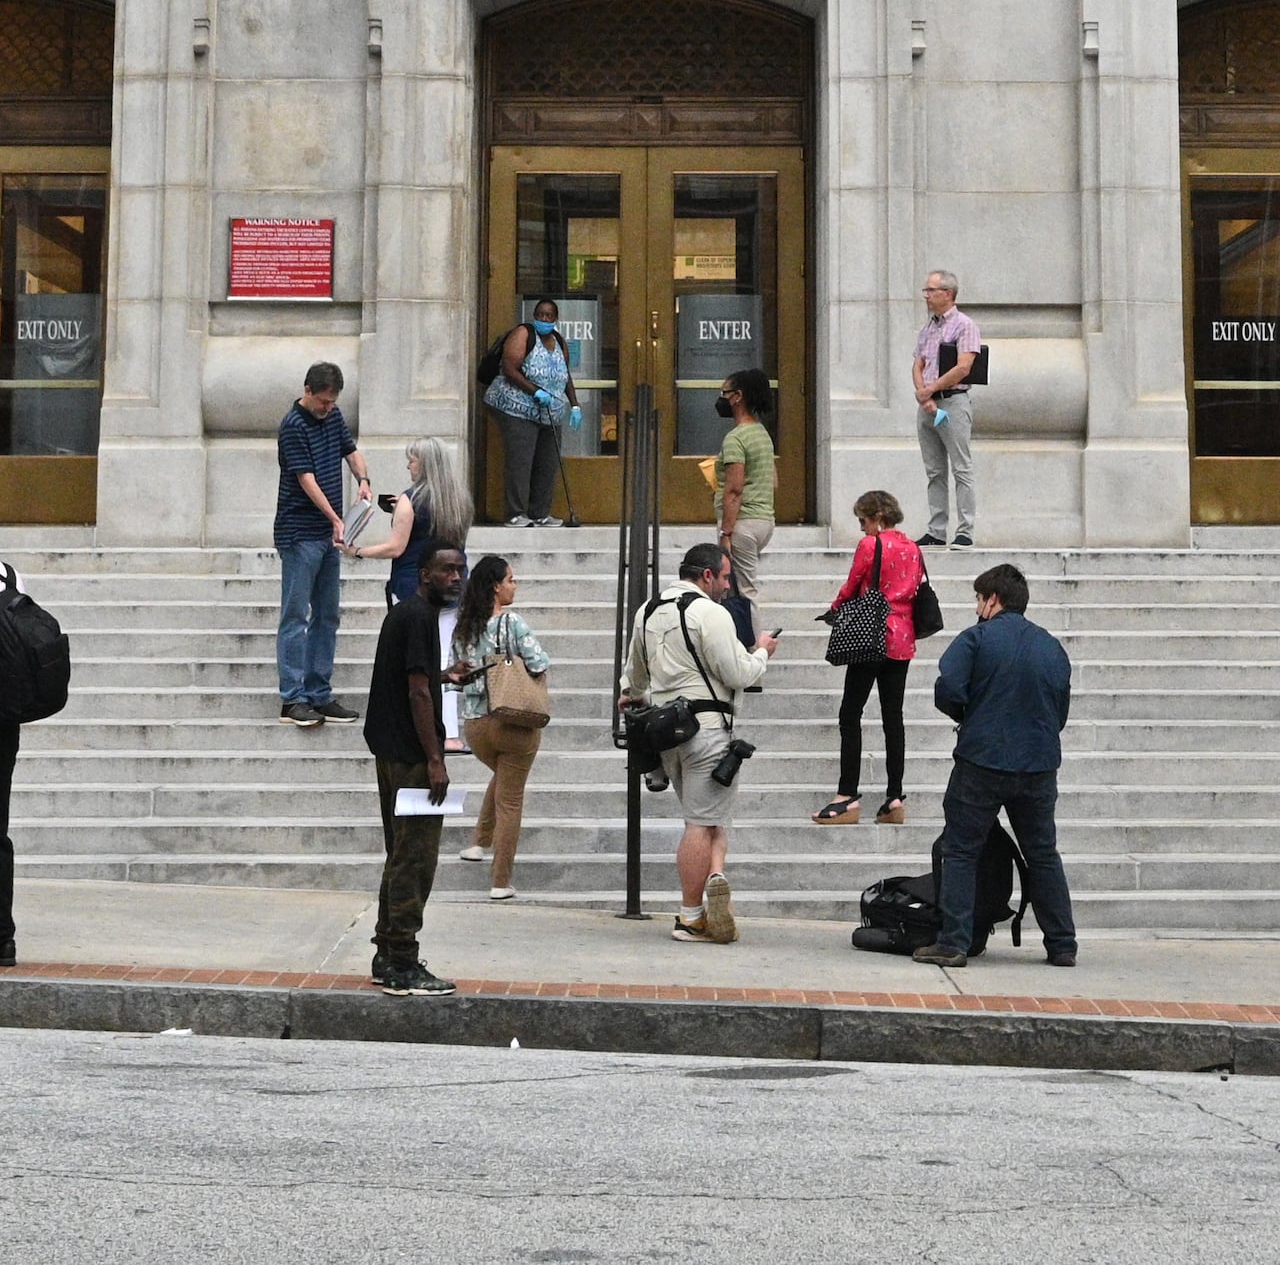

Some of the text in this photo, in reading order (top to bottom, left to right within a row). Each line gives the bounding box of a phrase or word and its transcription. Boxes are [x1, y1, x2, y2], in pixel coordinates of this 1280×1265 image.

[244, 218, 321, 226] WARNING NOTICE
[17, 320, 83, 340] EXIT ONLY
[553, 320, 594, 340] NTER
[698, 320, 752, 340] ENTER
[1212, 322, 1276, 341] EXIT ONLY
